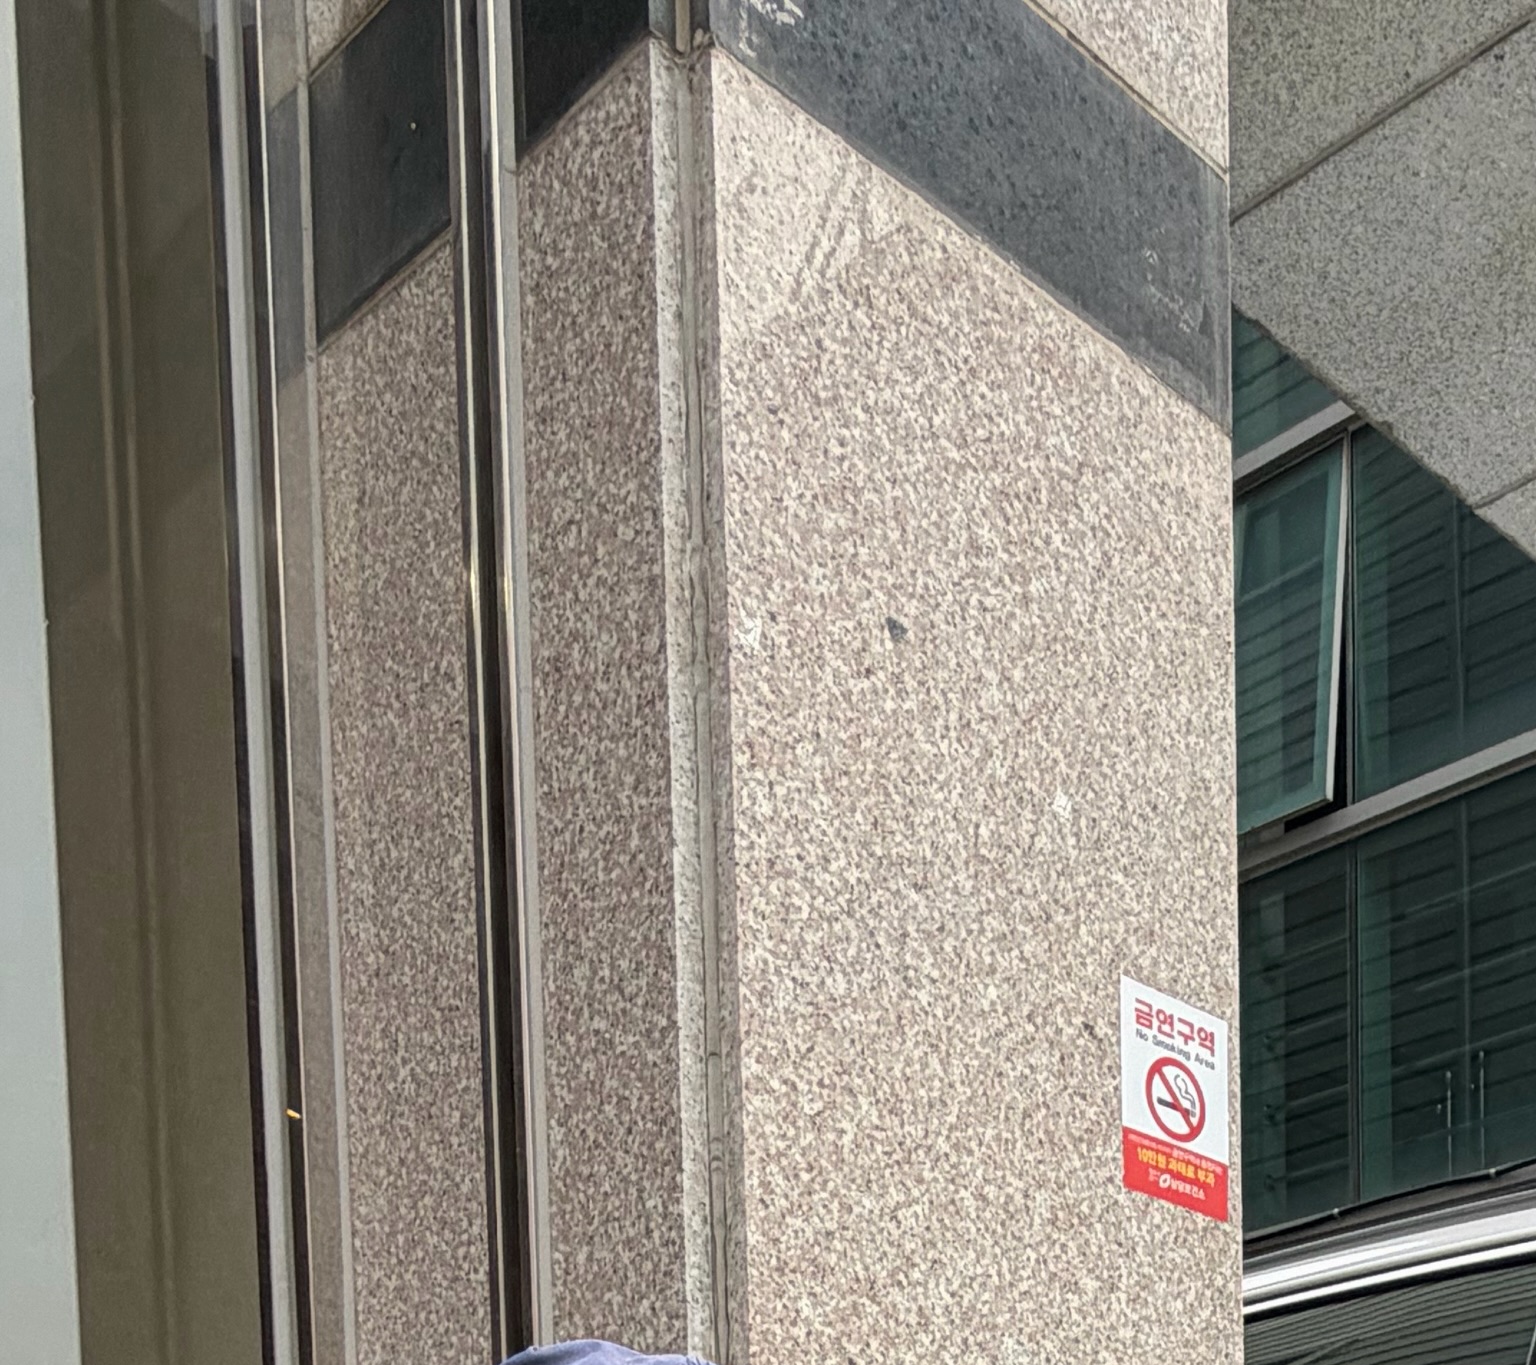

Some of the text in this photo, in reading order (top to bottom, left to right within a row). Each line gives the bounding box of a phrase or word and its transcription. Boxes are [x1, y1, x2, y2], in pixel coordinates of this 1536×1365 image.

[1134, 997, 1215, 1057] 금연구역
[1136, 1028, 1216, 1071] No Smoking Area
[1137, 1146, 1167, 1169] 10만원
[1168, 1158, 1196, 1180] 과태료
[1197, 1168, 1216, 1189] 부과
